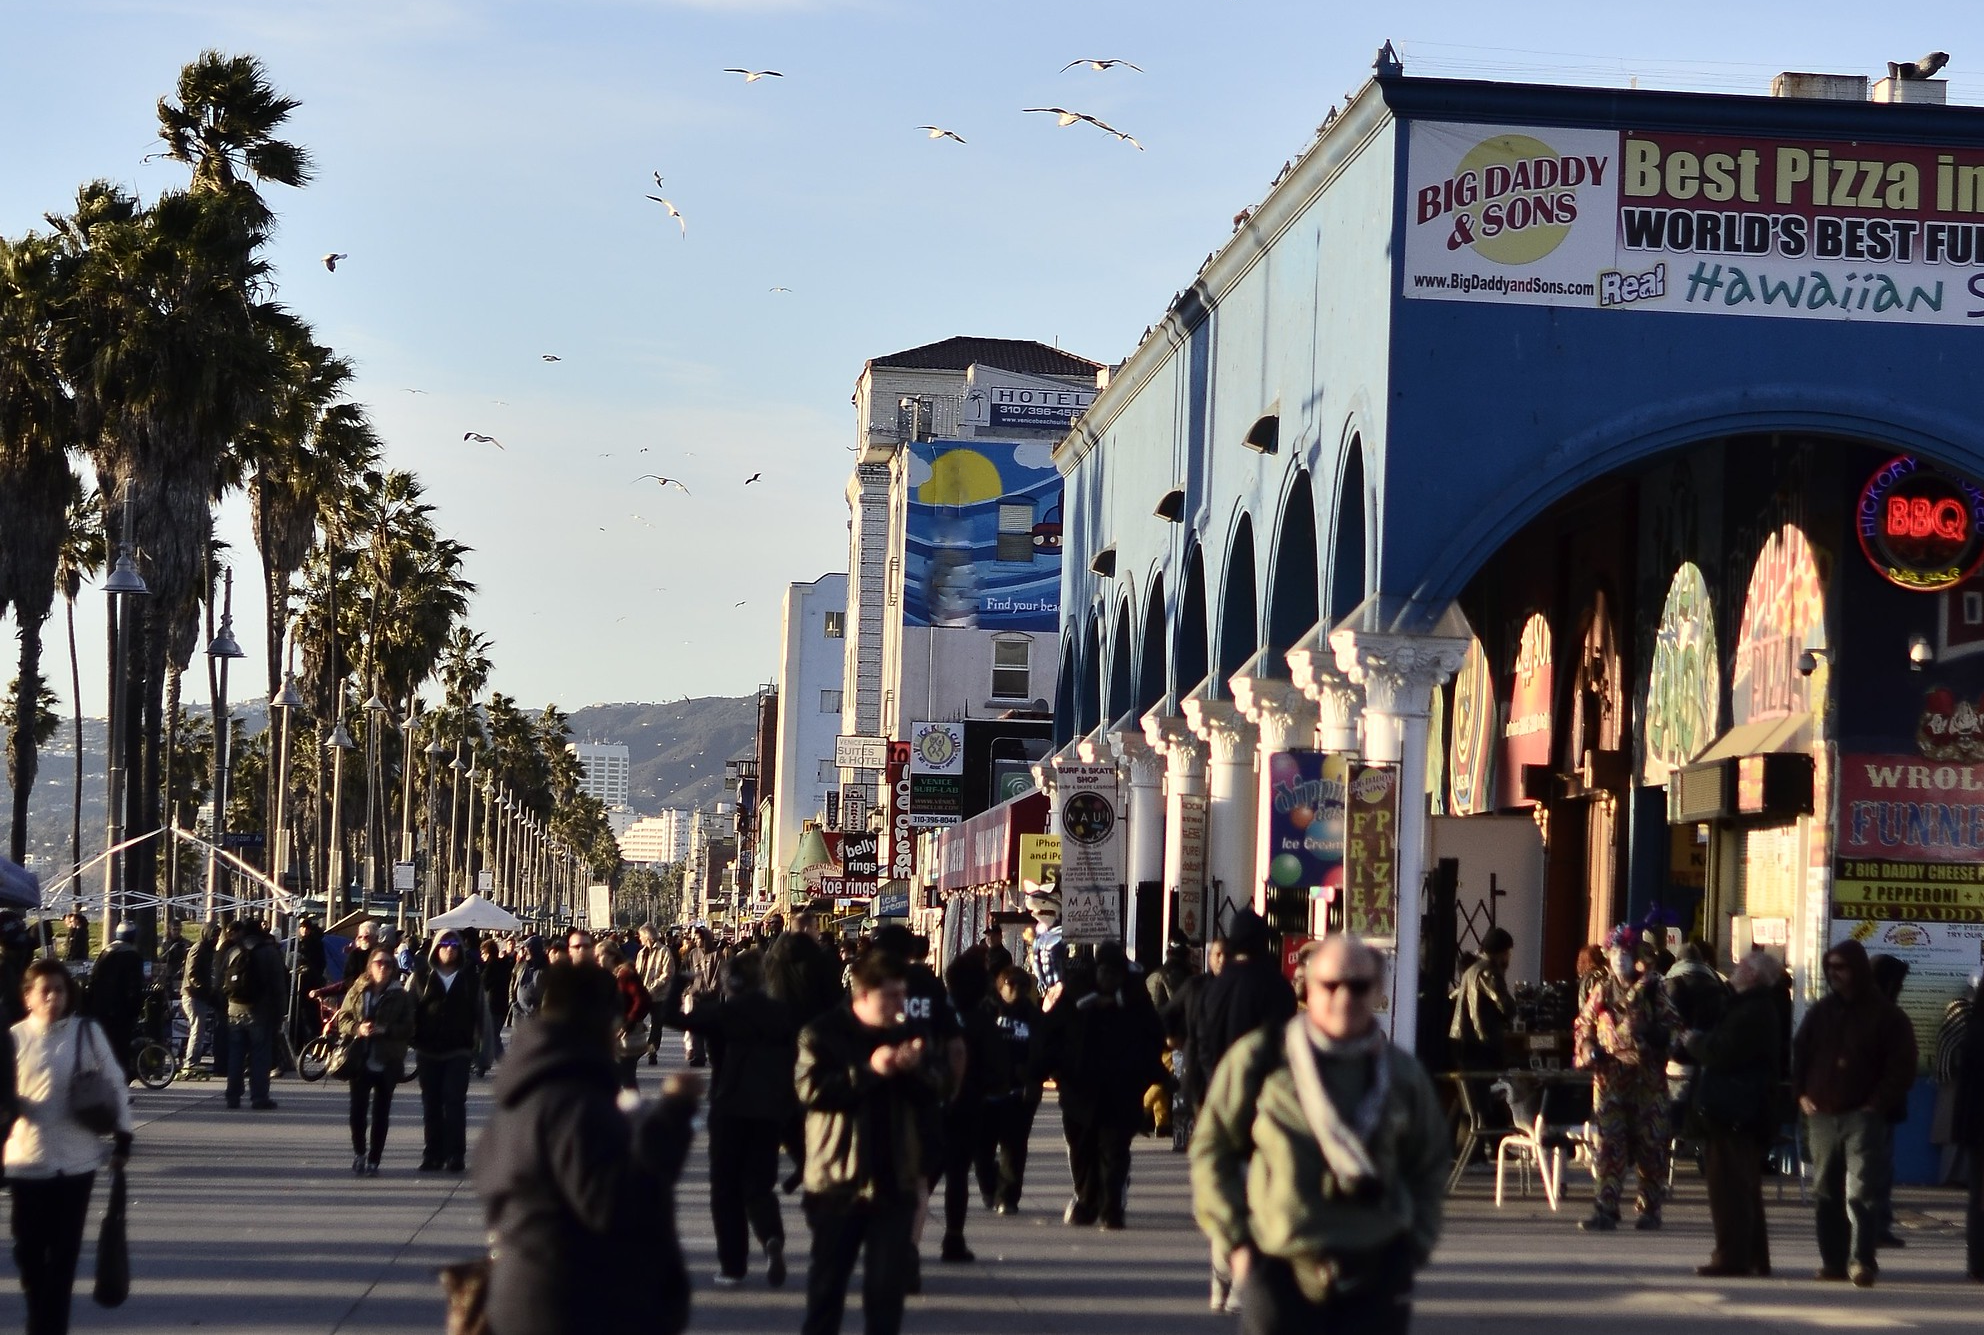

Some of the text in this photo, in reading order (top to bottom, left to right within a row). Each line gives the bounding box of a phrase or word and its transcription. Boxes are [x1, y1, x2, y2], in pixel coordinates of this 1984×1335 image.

[1624, 139, 1984, 212] Best Pizza in
[1416, 156, 1609, 225] BIG DADDY
[1446, 192, 1578, 251] & SONS
[1622, 207, 1807, 258] WORLD'S
[1814, 216, 1919, 262] BEST
[1414, 273, 1594, 296] www.BigDaddyandSons.com
[1600, 263, 1665, 305] Real
[999, 390, 1089, 406] HOTEL
[1861, 456, 1917, 537] HICKORY
[1887, 496, 1968, 542] BBQ
[986, 597, 1011, 610] Find
[1013, 602, 1038, 614] your
[837, 746, 875, 756] SUITES
[839, 756, 884, 766] & HOTEL
[1058, 766, 1080, 774] SURF
[921, 778, 953, 786] VENICE
[1076, 776, 1099, 784] SHOP
[845, 839, 877, 858] belly
[1281, 837, 1300, 850] Ice
[1029, 852, 1048, 860] and
[848, 859, 877, 874] rings
[1373, 810, 1394, 934] PIZZA
[1844, 862, 1853, 877] 2
[1856, 863, 1879, 878] BIG
[1882, 863, 1926, 879] DADDY
[1928, 864, 1975, 880] CHEESE
[822, 877, 842, 894] toe
[846, 878, 877, 897] rings
[1863, 885, 1872, 900] 2
[1877, 886, 1958, 903] PEPPERONI
[880, 900, 908, 913] cream
[881, 895, 898, 905] ice
[1842, 905, 1890, 919] BIG
